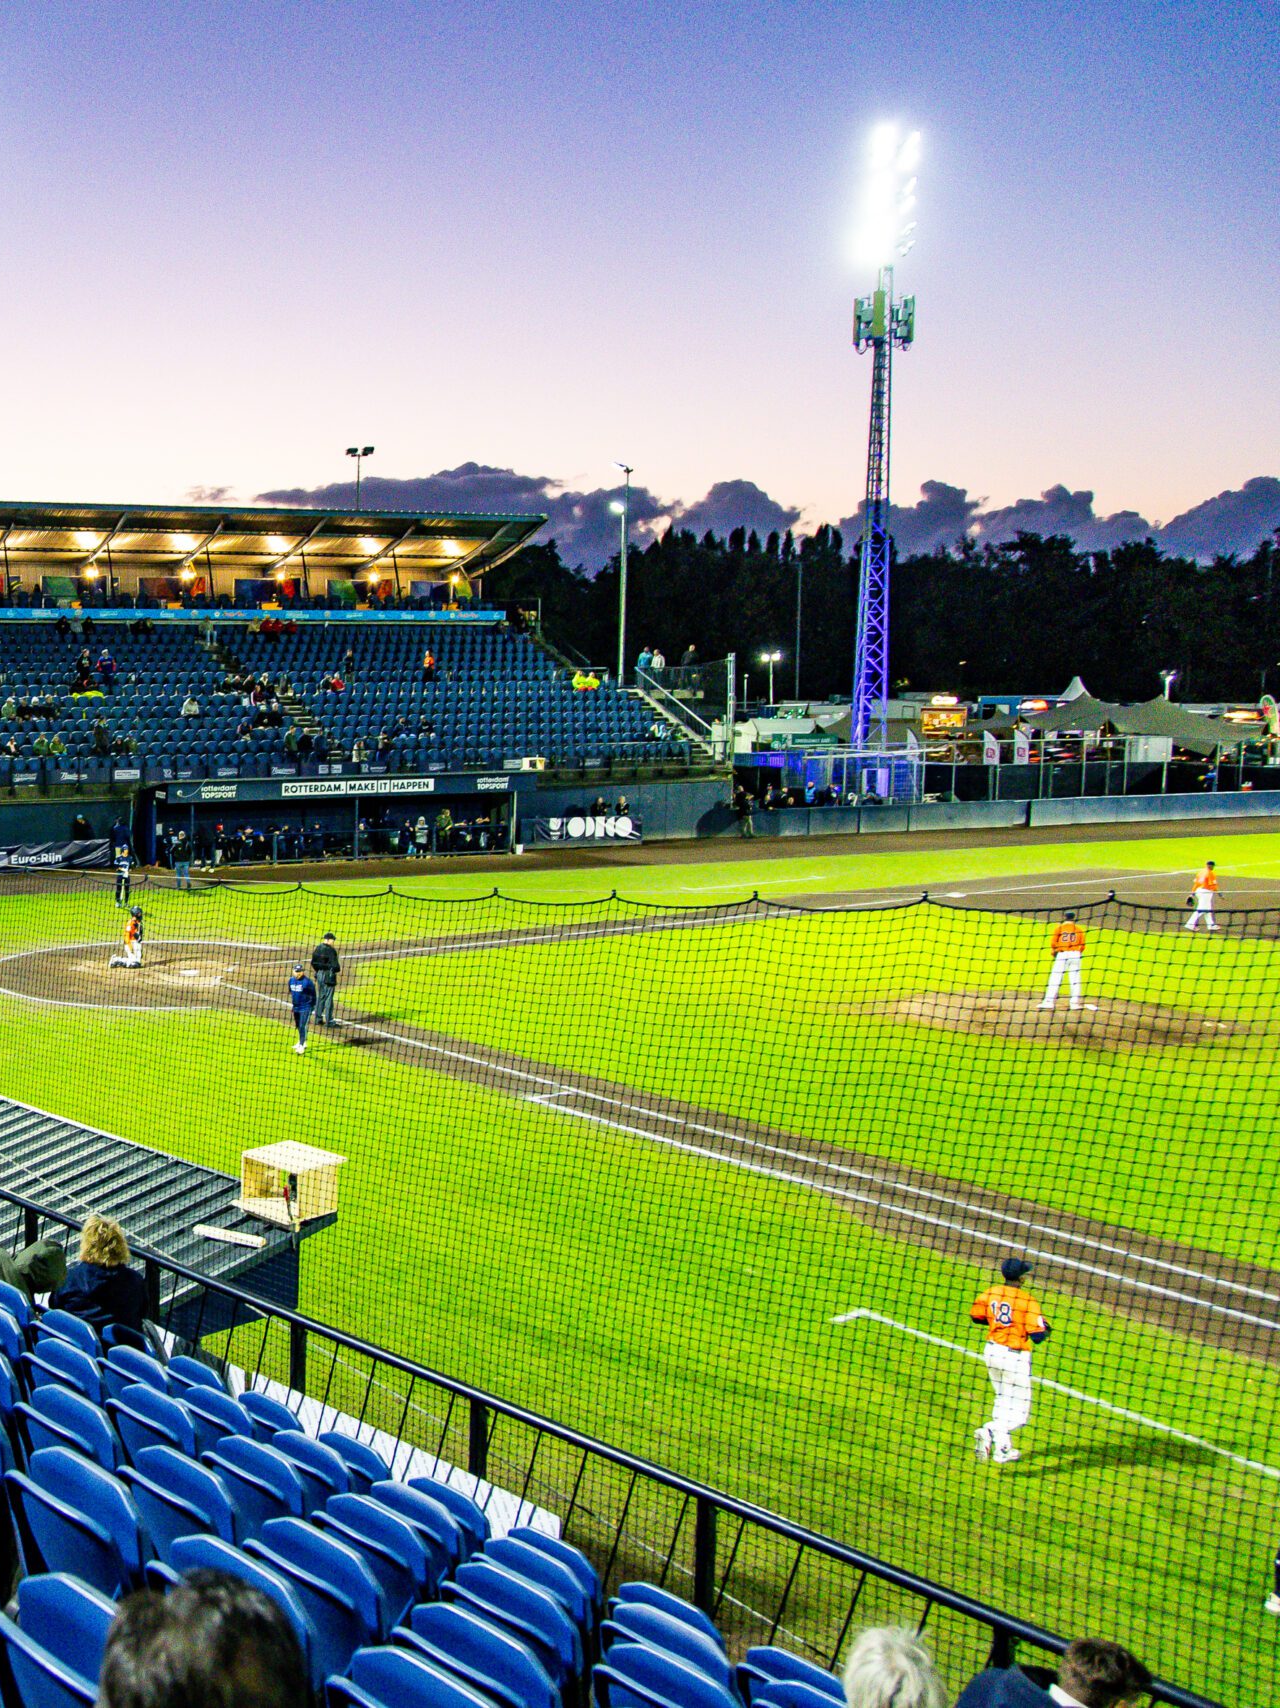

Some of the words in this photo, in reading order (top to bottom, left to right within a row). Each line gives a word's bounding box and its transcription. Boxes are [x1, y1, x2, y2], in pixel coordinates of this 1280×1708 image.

[283, 784, 345, 794] ROTTERDAM.
[348, 782, 376, 792] MAKE
[379, 782, 388, 791] IT
[392, 781, 430, 790] HAPPEN
[476, 782, 509, 790] TOPSPORT
[200, 791, 237, 799] TOPSPORT
[11, 852, 63, 865] Euro-Rijn
[990, 1300, 1014, 1327] 18
